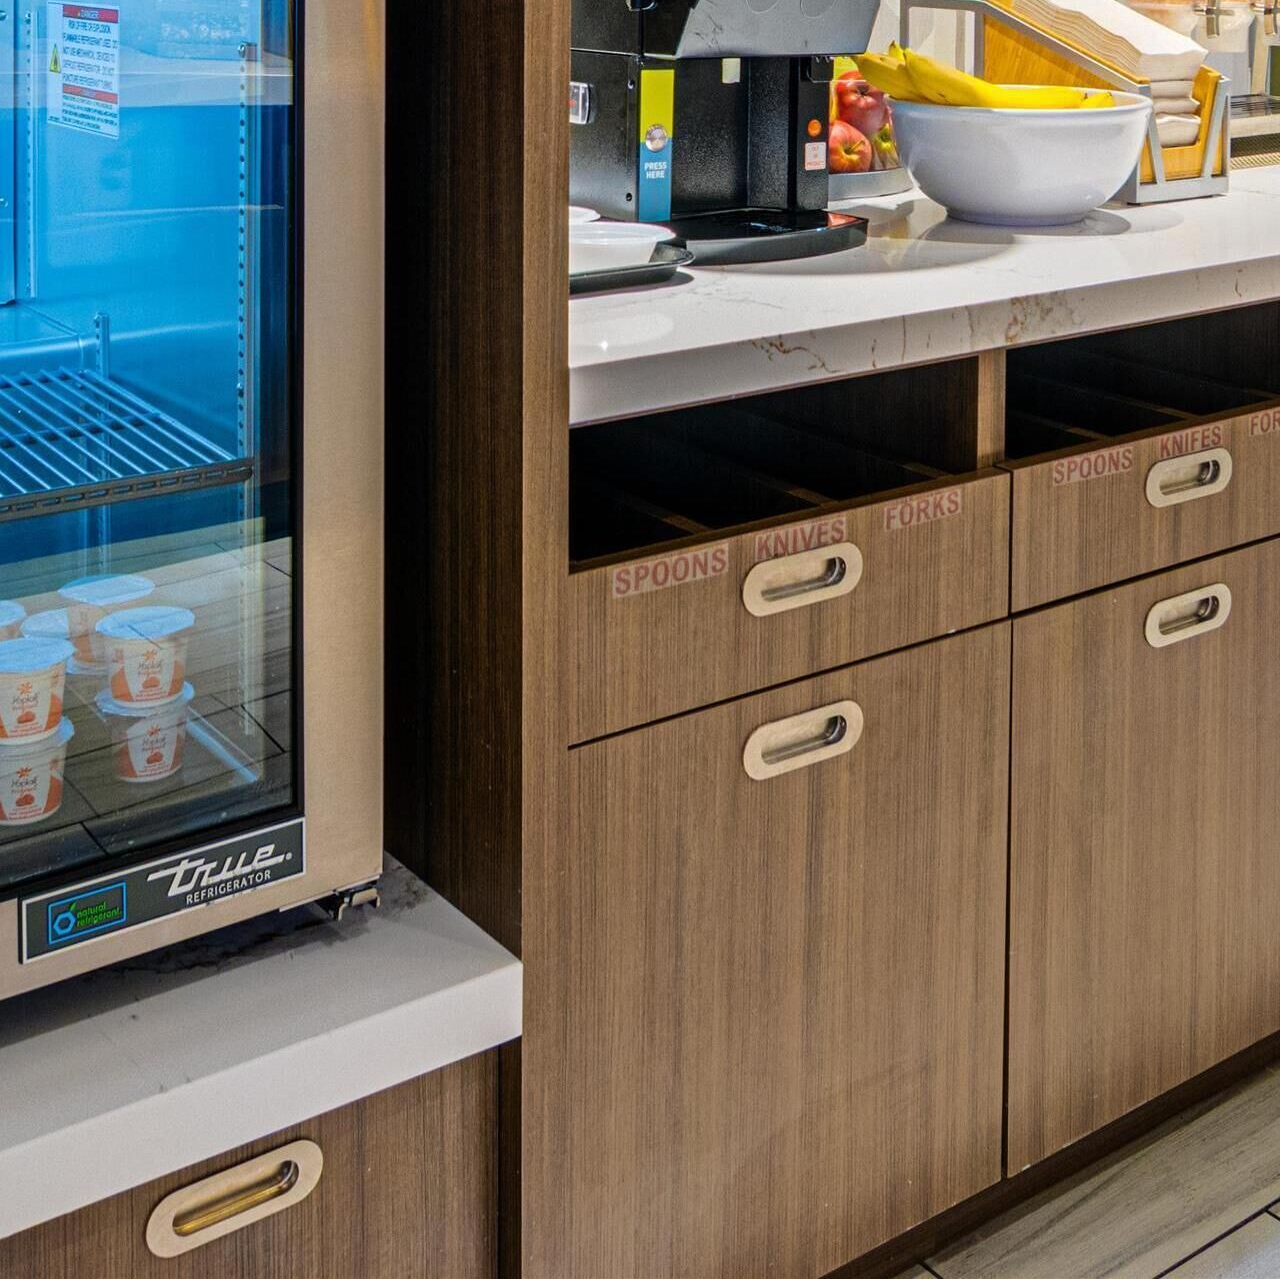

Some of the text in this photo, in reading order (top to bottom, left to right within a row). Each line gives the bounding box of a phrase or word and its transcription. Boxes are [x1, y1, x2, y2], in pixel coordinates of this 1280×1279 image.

[644, 161, 667, 171] PRESS
[645, 170, 665, 179] HERE
[1054, 448, 1134, 485] SPOONS
[1159, 425, 1222, 457] KNIFES
[614, 490, 961, 596] SPOONS KNIVES FORKS
[186, 869, 271, 905] REFRIGERATOR
[76, 901, 107, 919] natural
